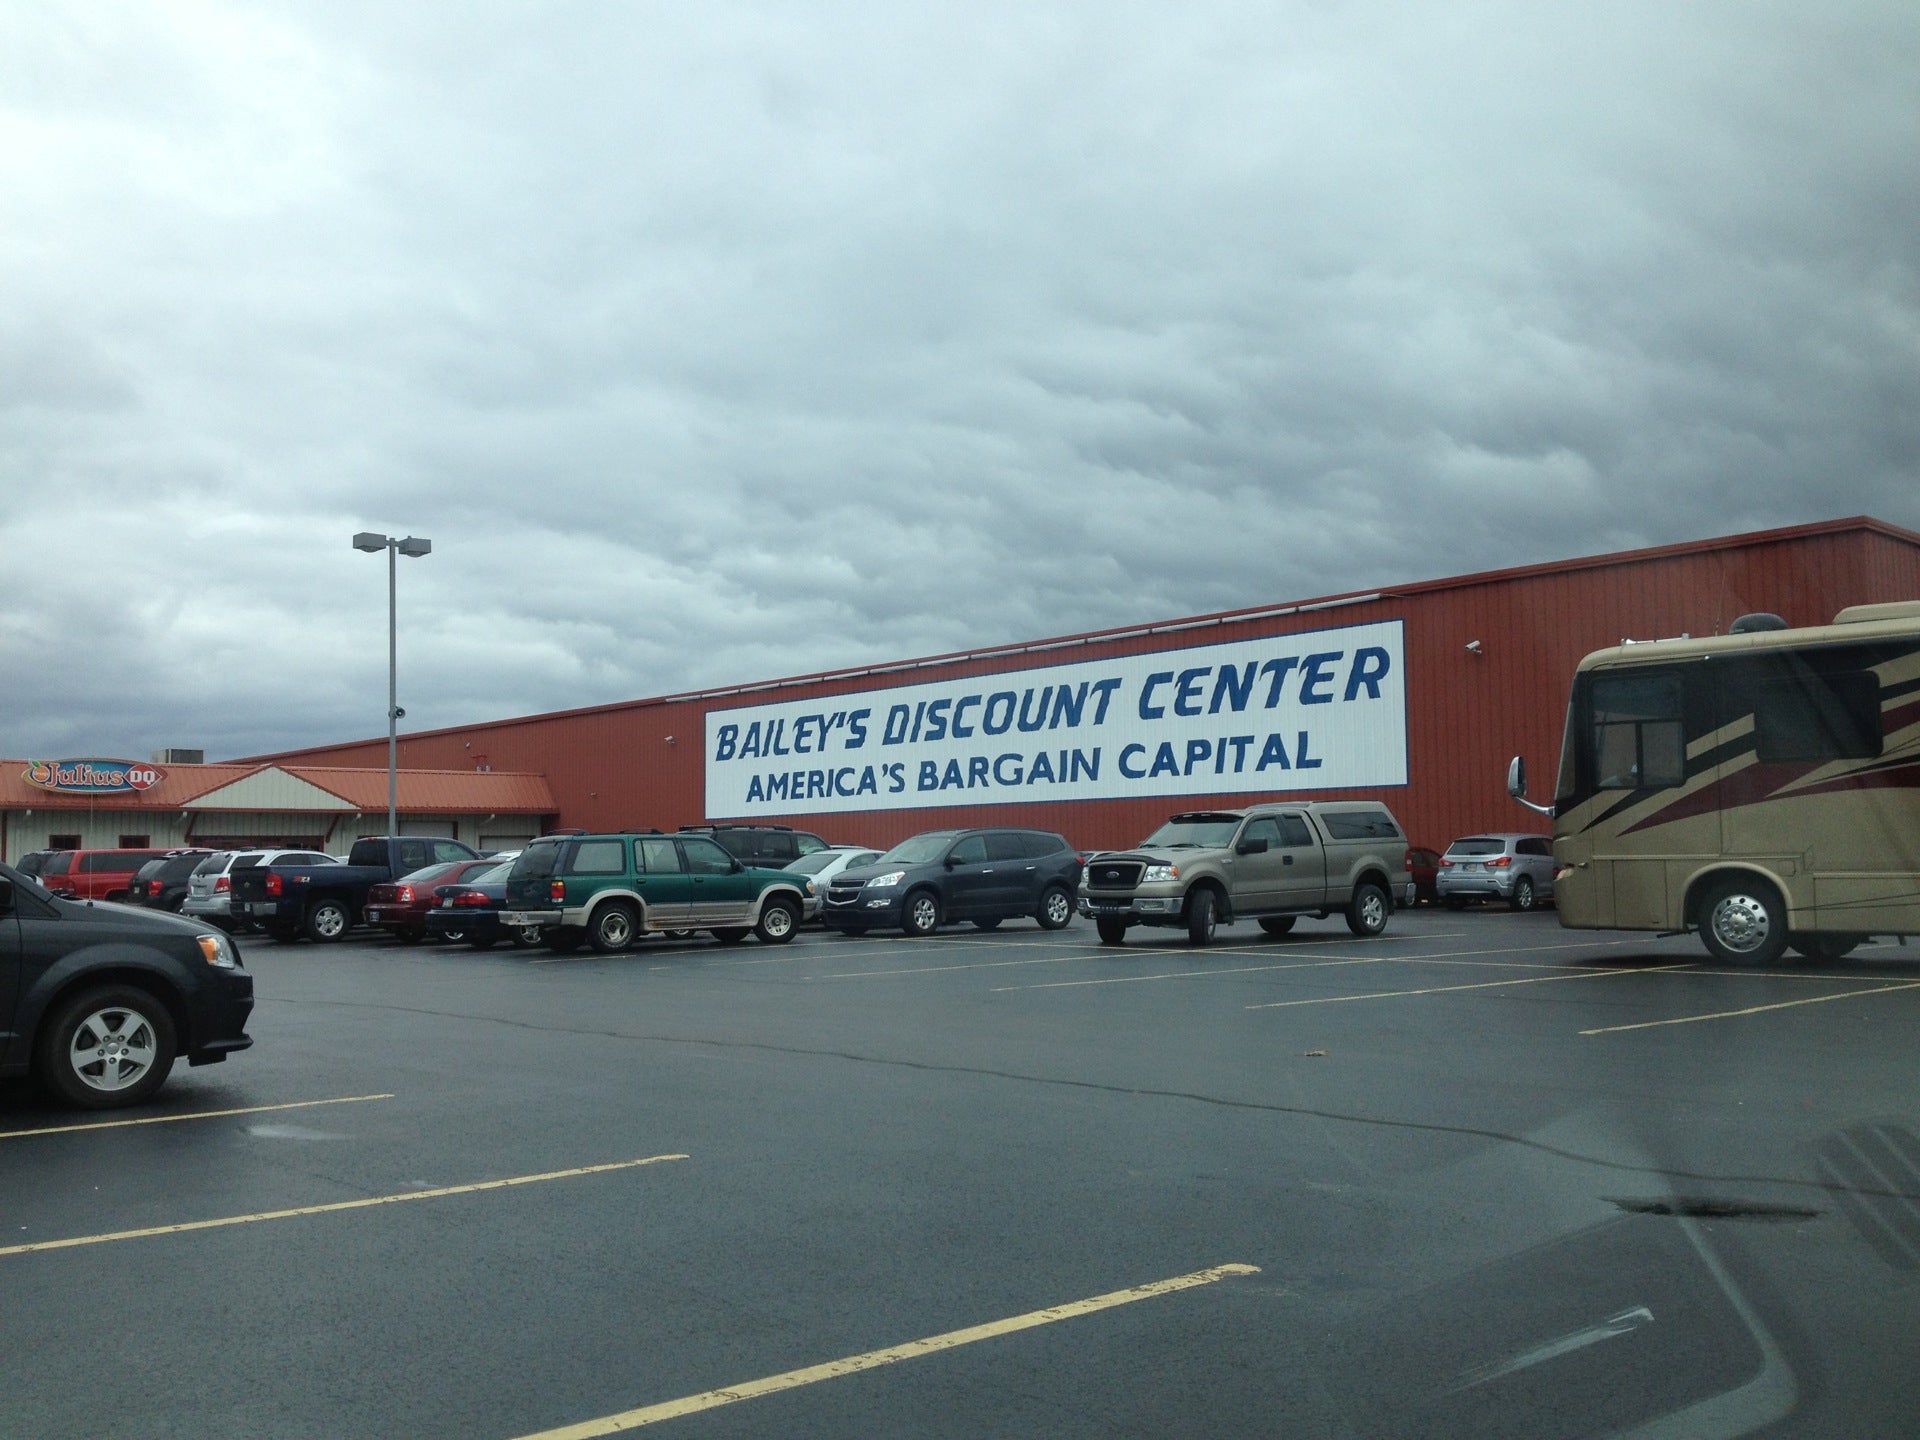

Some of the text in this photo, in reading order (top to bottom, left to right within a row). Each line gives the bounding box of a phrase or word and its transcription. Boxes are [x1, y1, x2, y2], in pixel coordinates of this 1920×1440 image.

[716, 647, 1391, 762] BAILEY'S DISCOUNT CENTER
[45, 762, 156, 787] Julius DQ
[746, 731, 1323, 803] AMERICA'S BARGAIN CAPITAL
